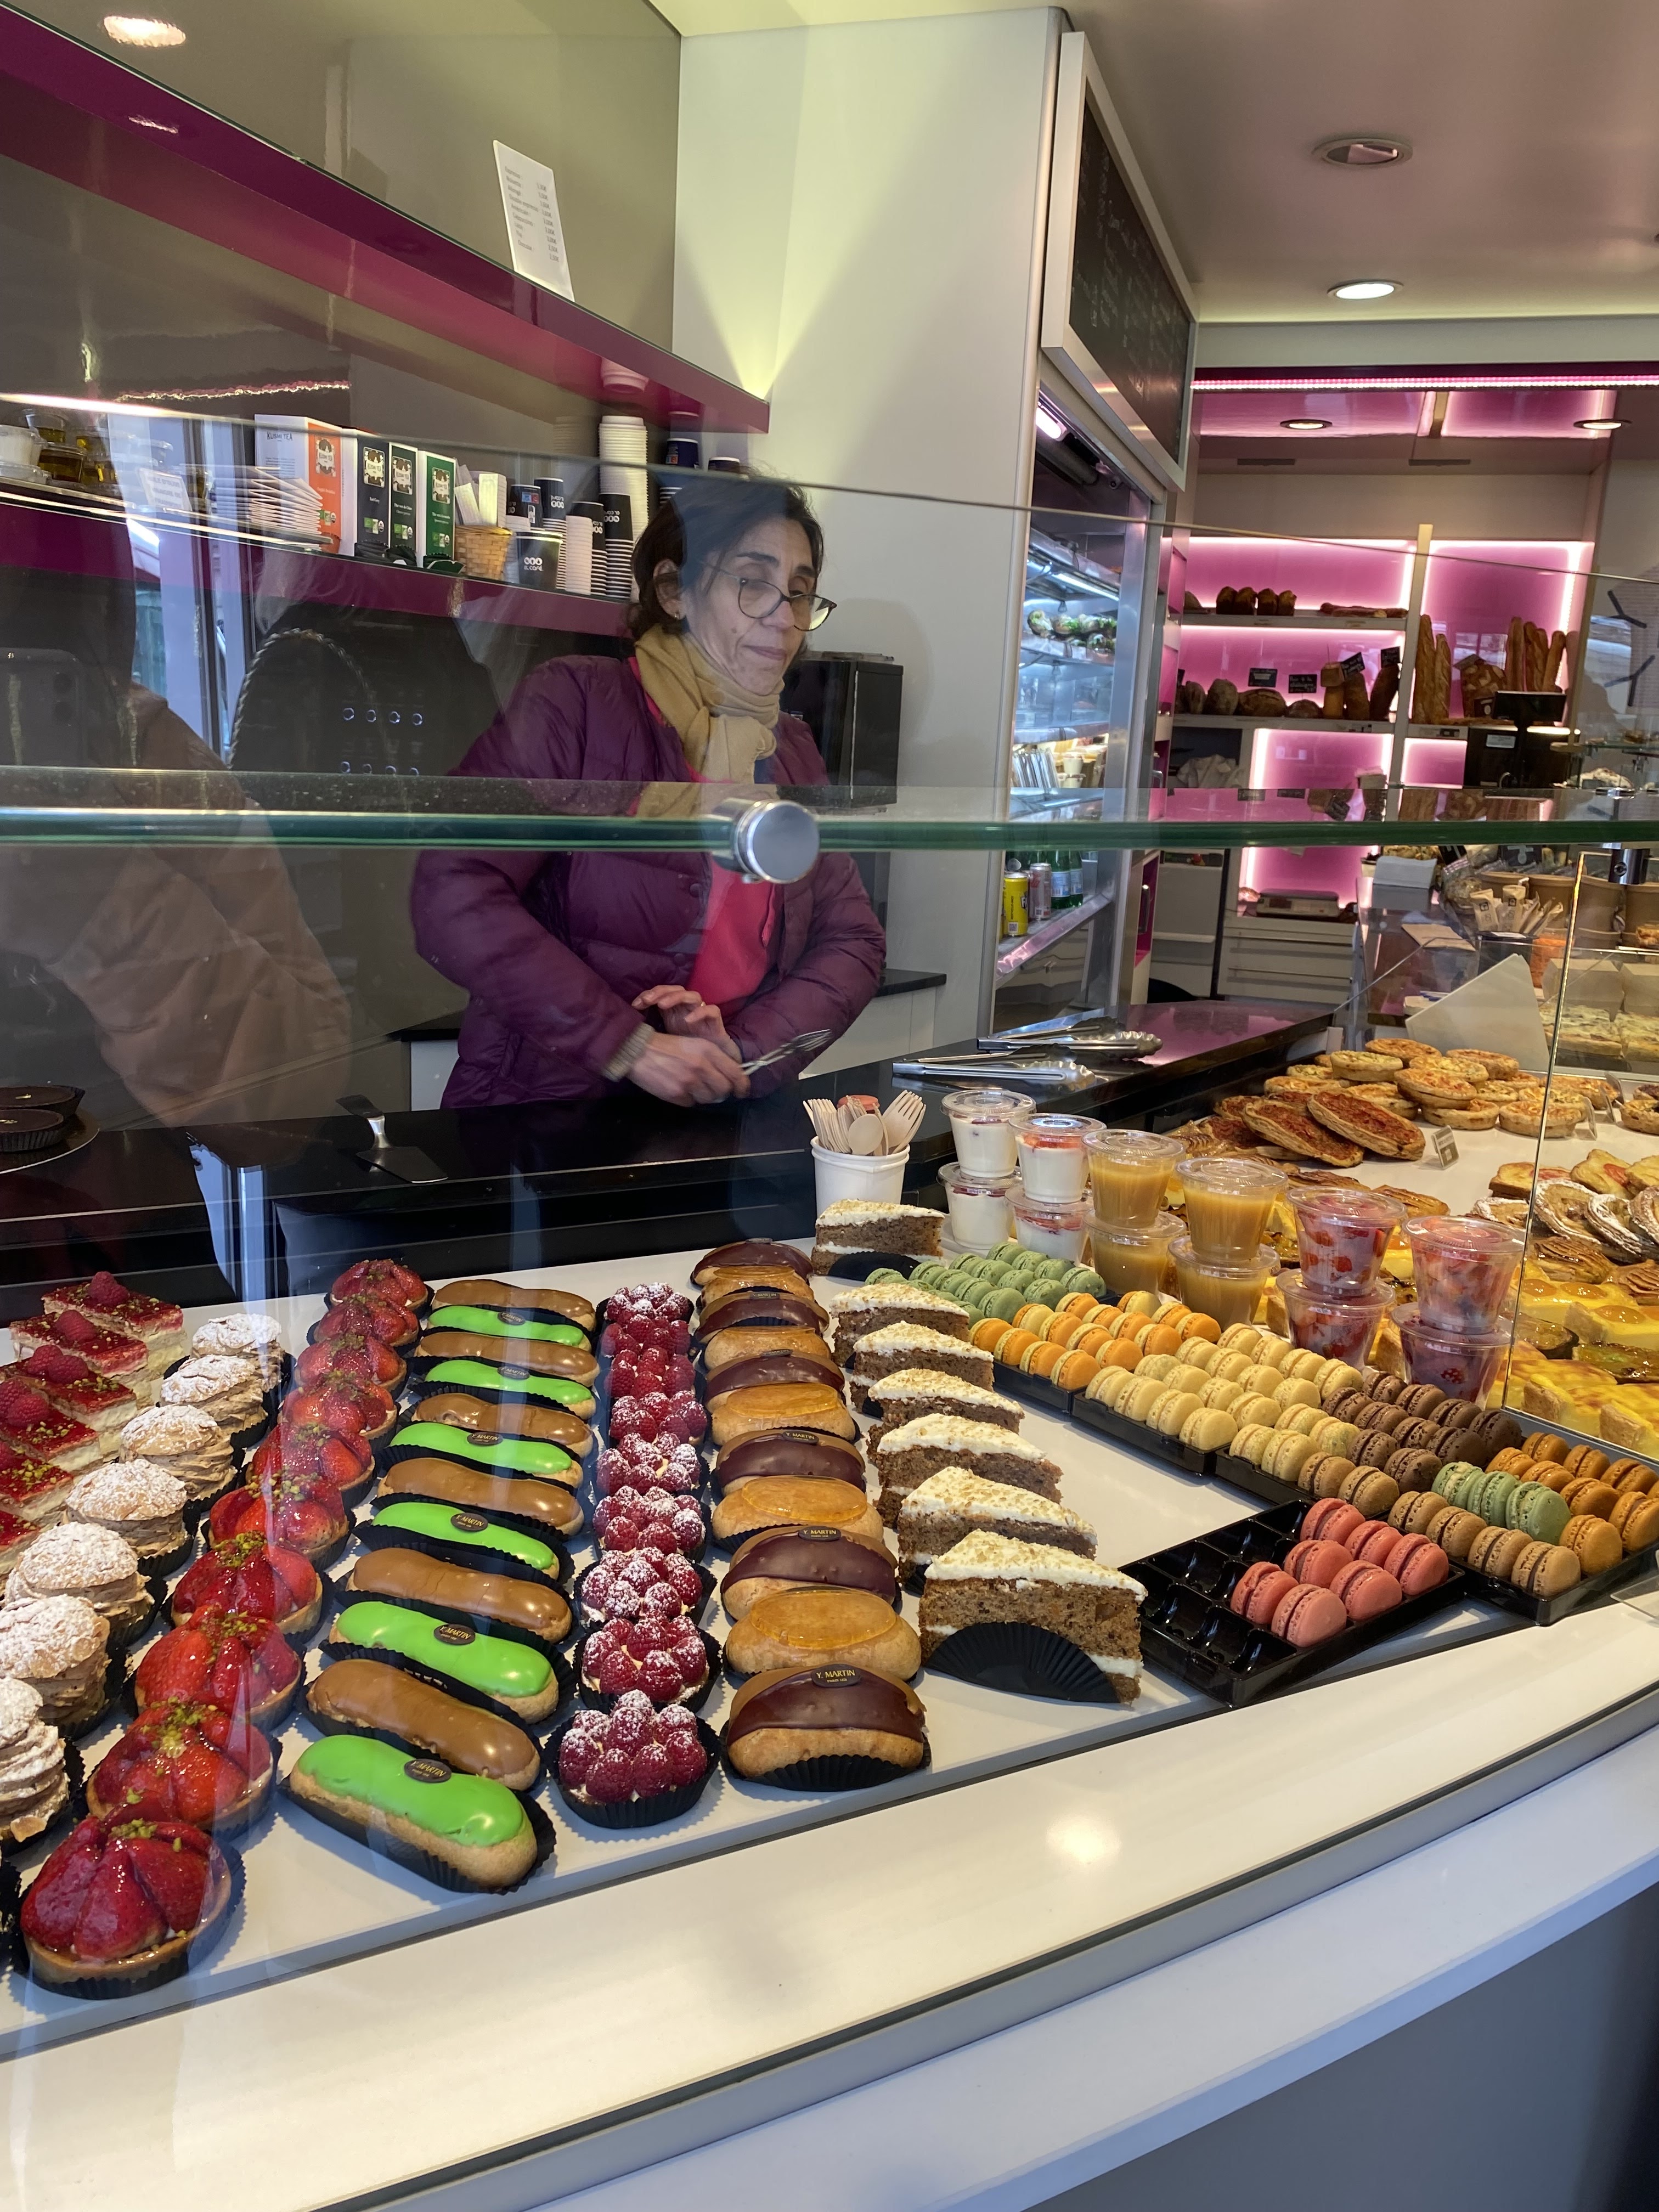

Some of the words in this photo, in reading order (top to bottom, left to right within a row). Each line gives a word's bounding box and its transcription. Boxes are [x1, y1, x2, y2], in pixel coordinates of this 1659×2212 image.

[267, 431, 283, 440] KUSMI
[283, 432, 293, 441] TEA
[461, 1516, 484, 1527] MARTIN
[445, 1627, 472, 1639] MARTIN
[825, 1669, 855, 1678] MARTIN
[416, 1763, 447, 1777] MARTIN
